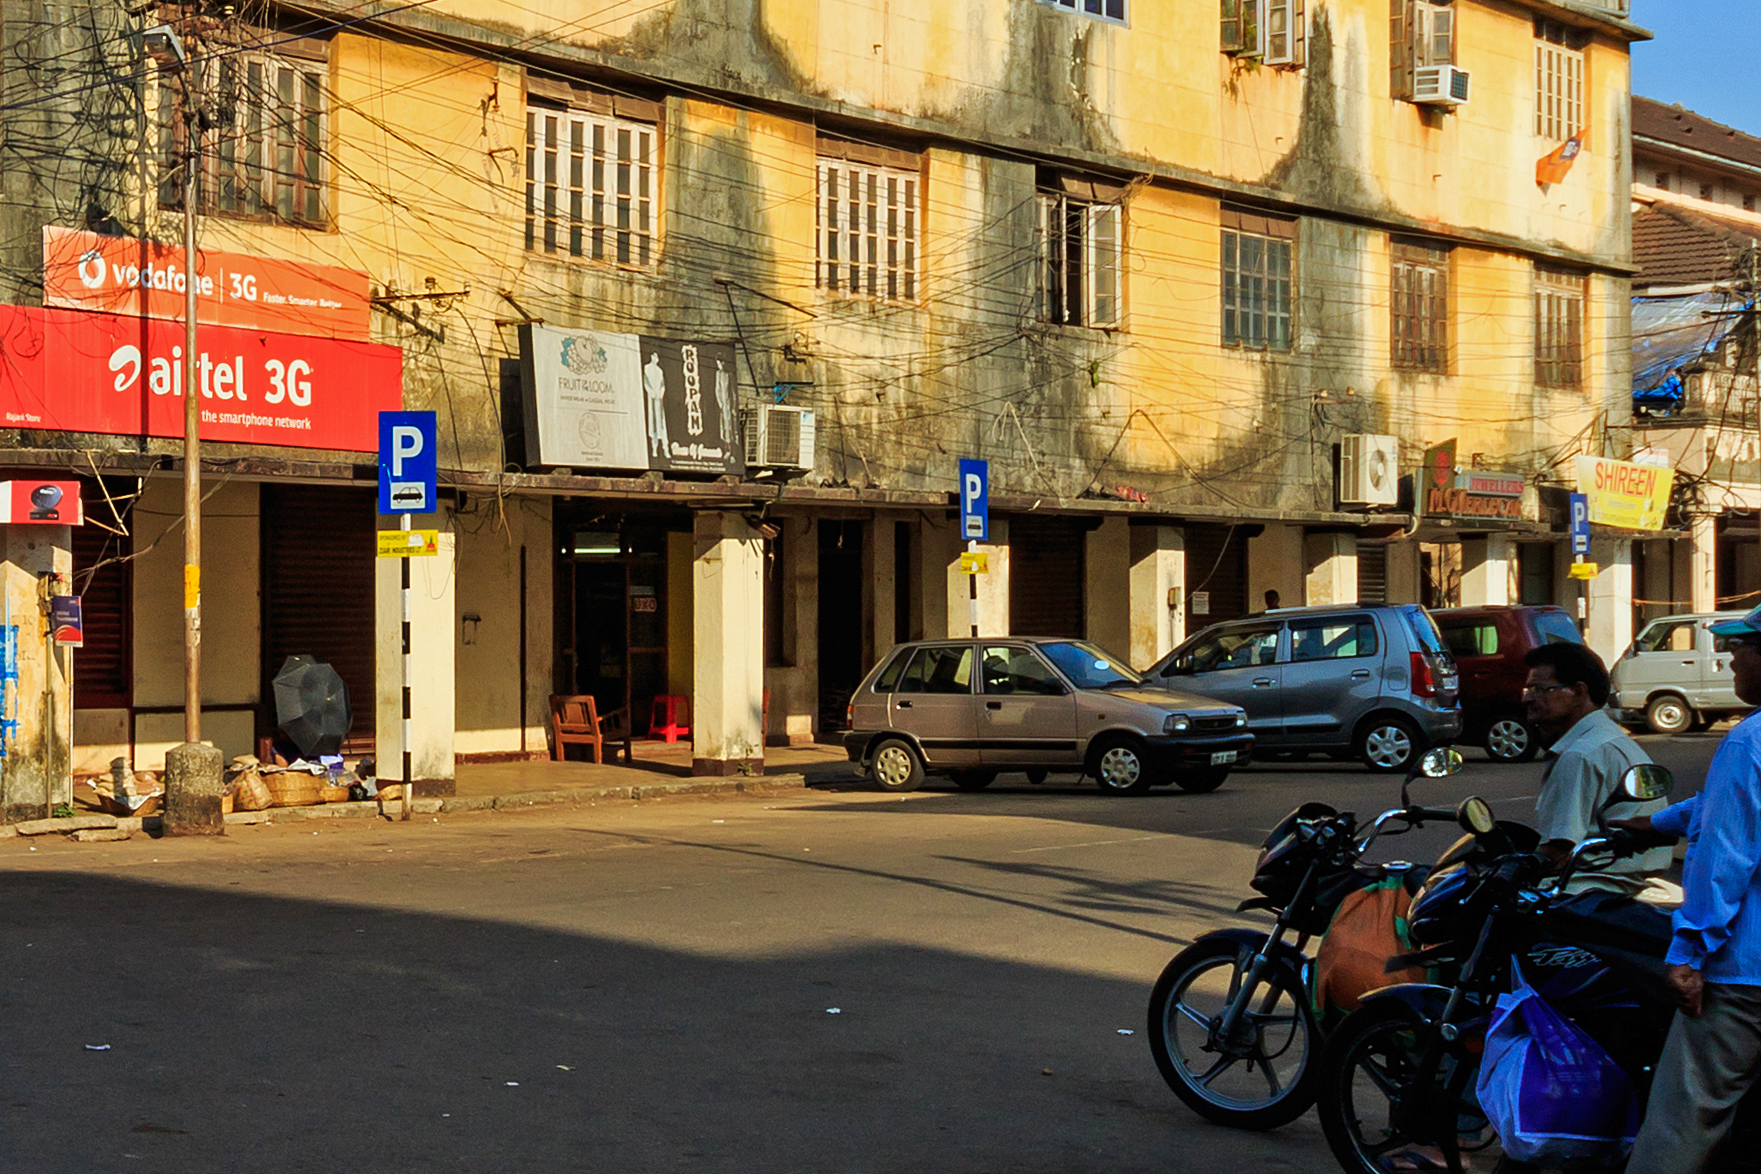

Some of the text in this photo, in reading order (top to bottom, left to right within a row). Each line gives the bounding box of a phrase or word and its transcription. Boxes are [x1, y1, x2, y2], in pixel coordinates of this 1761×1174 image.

[229, 272, 257, 301] 3G
[149, 345, 311, 406] aitel 3G
[201, 410, 311, 430] the smartphone network
[392, 426, 423, 476] P
[966, 473, 982, 513] P
[1595, 461, 1657, 497] SHIREEN
[1574, 502, 1585, 532] P
